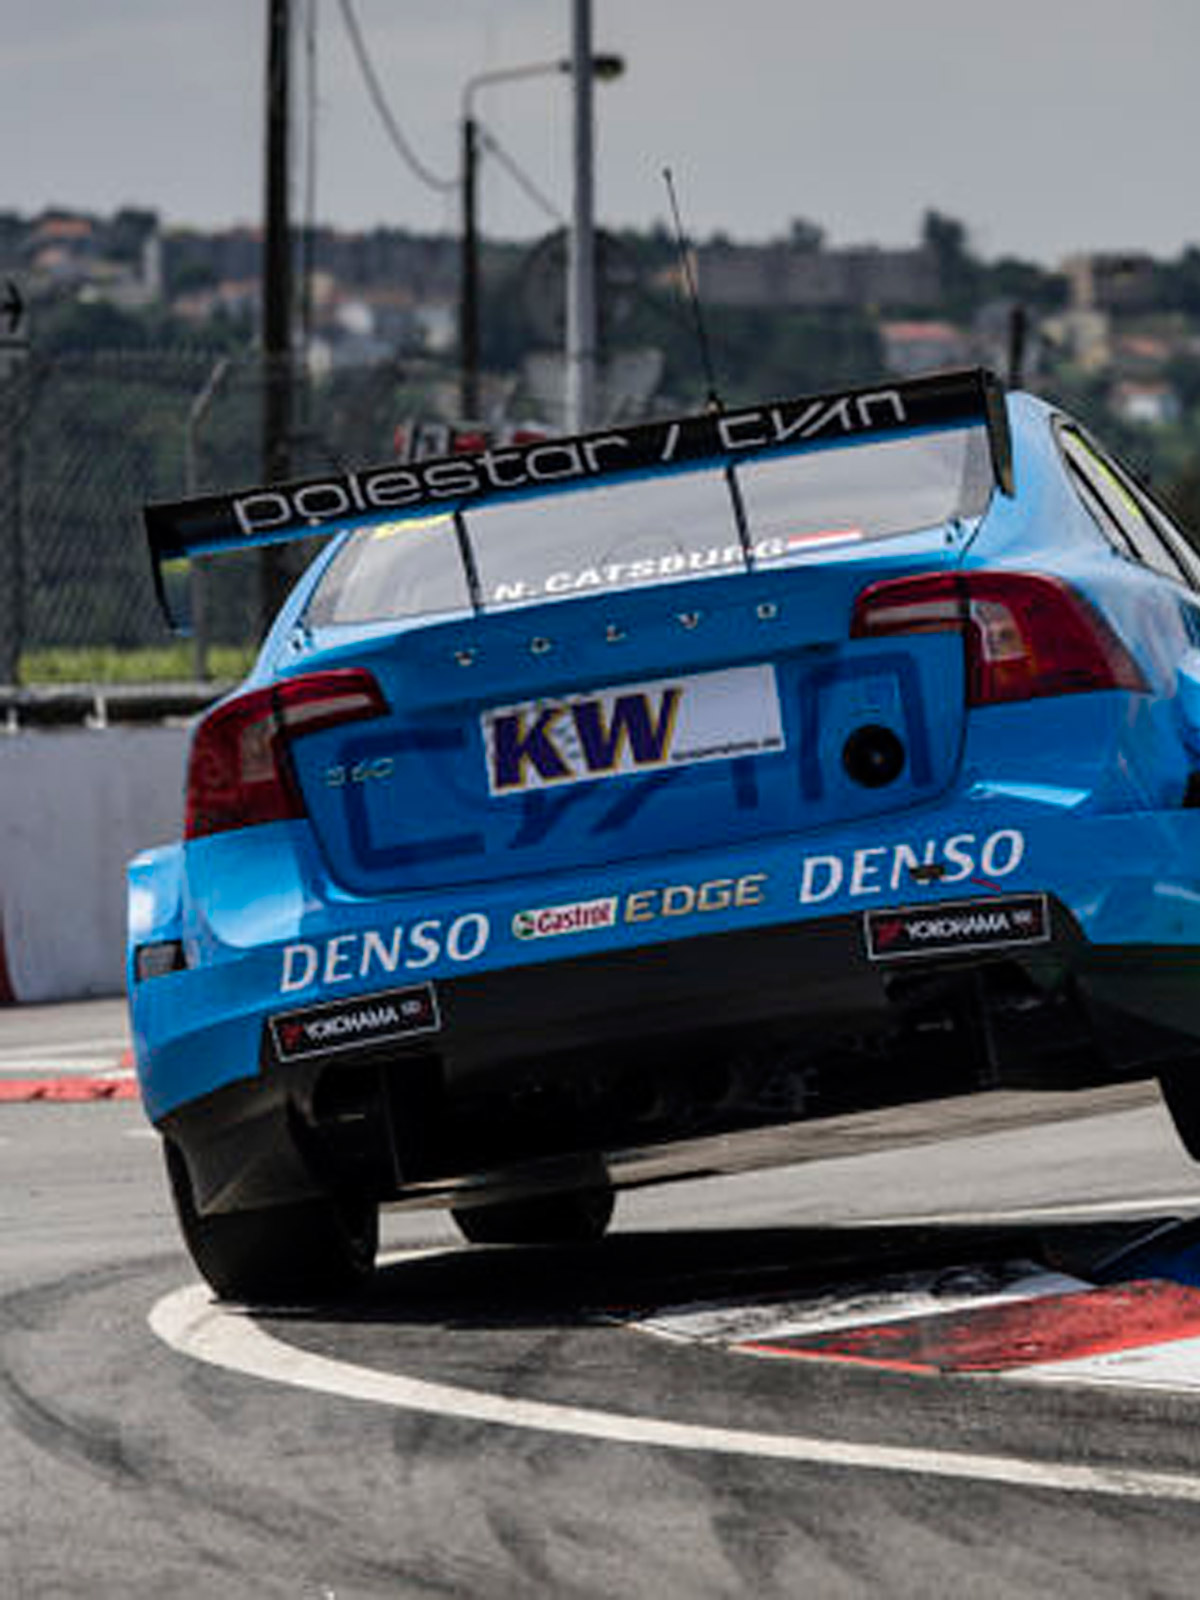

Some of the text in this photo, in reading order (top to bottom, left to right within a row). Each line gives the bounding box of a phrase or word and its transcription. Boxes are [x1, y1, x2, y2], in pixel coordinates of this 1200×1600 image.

[233, 431, 628, 534] polestar
[494, 580, 537, 602] N.
[454, 602, 782, 667] VOLVO
[493, 687, 682, 790] KW
[800, 829, 1025, 904] DENSO
[279, 873, 767, 993] DENSO Castrol EDGE
[906, 913, 1010, 940] YOKOHAMA
[304, 1005, 399, 1041] YOKOHAMA
